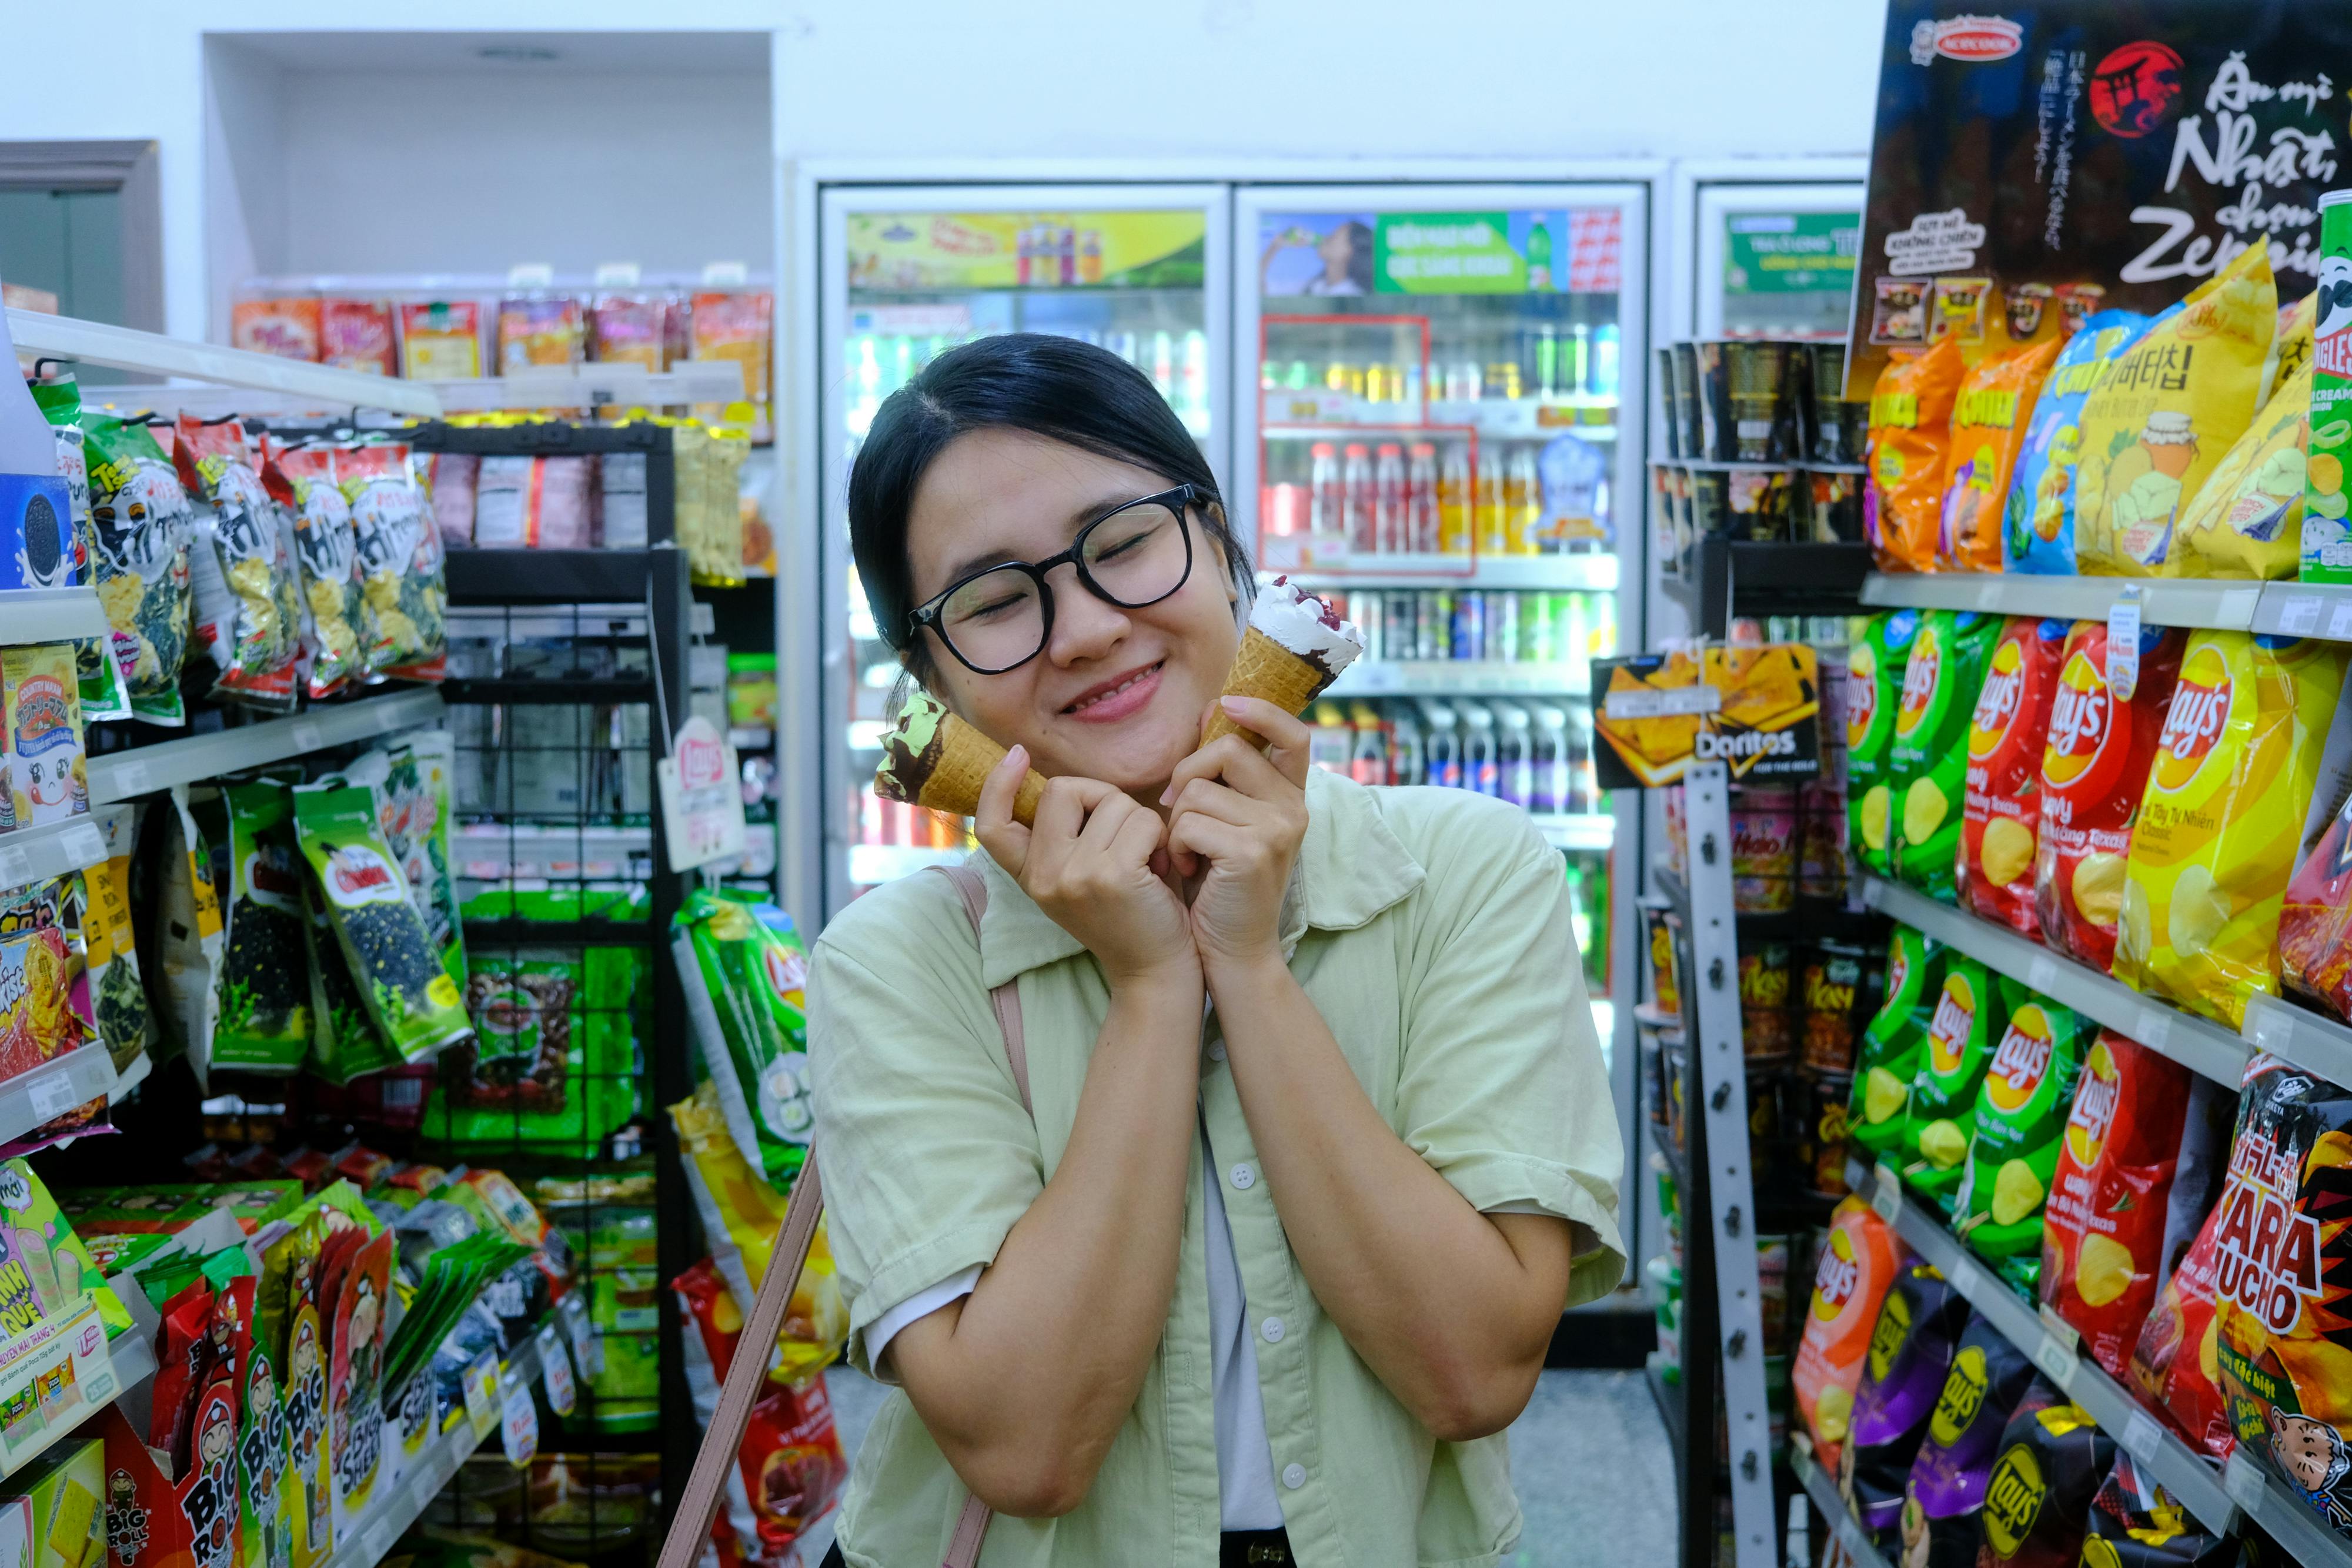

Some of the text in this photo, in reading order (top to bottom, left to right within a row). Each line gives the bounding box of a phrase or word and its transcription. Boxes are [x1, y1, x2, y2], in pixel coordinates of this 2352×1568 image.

[20, 680, 45, 701] COUNTRY
[1695, 730, 1796, 760] Doritos
[2141, 822, 2172, 841] Classic
[2182, 809, 2216, 831] Nhiên
[2089, 827, 2129, 849] Texas
[1989, 1024, 2052, 1091] Lay's
[2070, 1068, 2116, 1142] Lay's
[2216, 1246, 2301, 1335] UCHO
[1, 1290, 45, 1338] QUẾ
[49, 1323, 56, 1333] 4
[7, 1368, 20, 1382] Bánh
[19, 1360, 29, 1375] quế
[2253, 1372, 2277, 1400] biệt
[249, 1447, 288, 1517] ROLL
[1985, 1472, 2040, 1530] Lay's
[107, 1529, 149, 1549] ROLL
